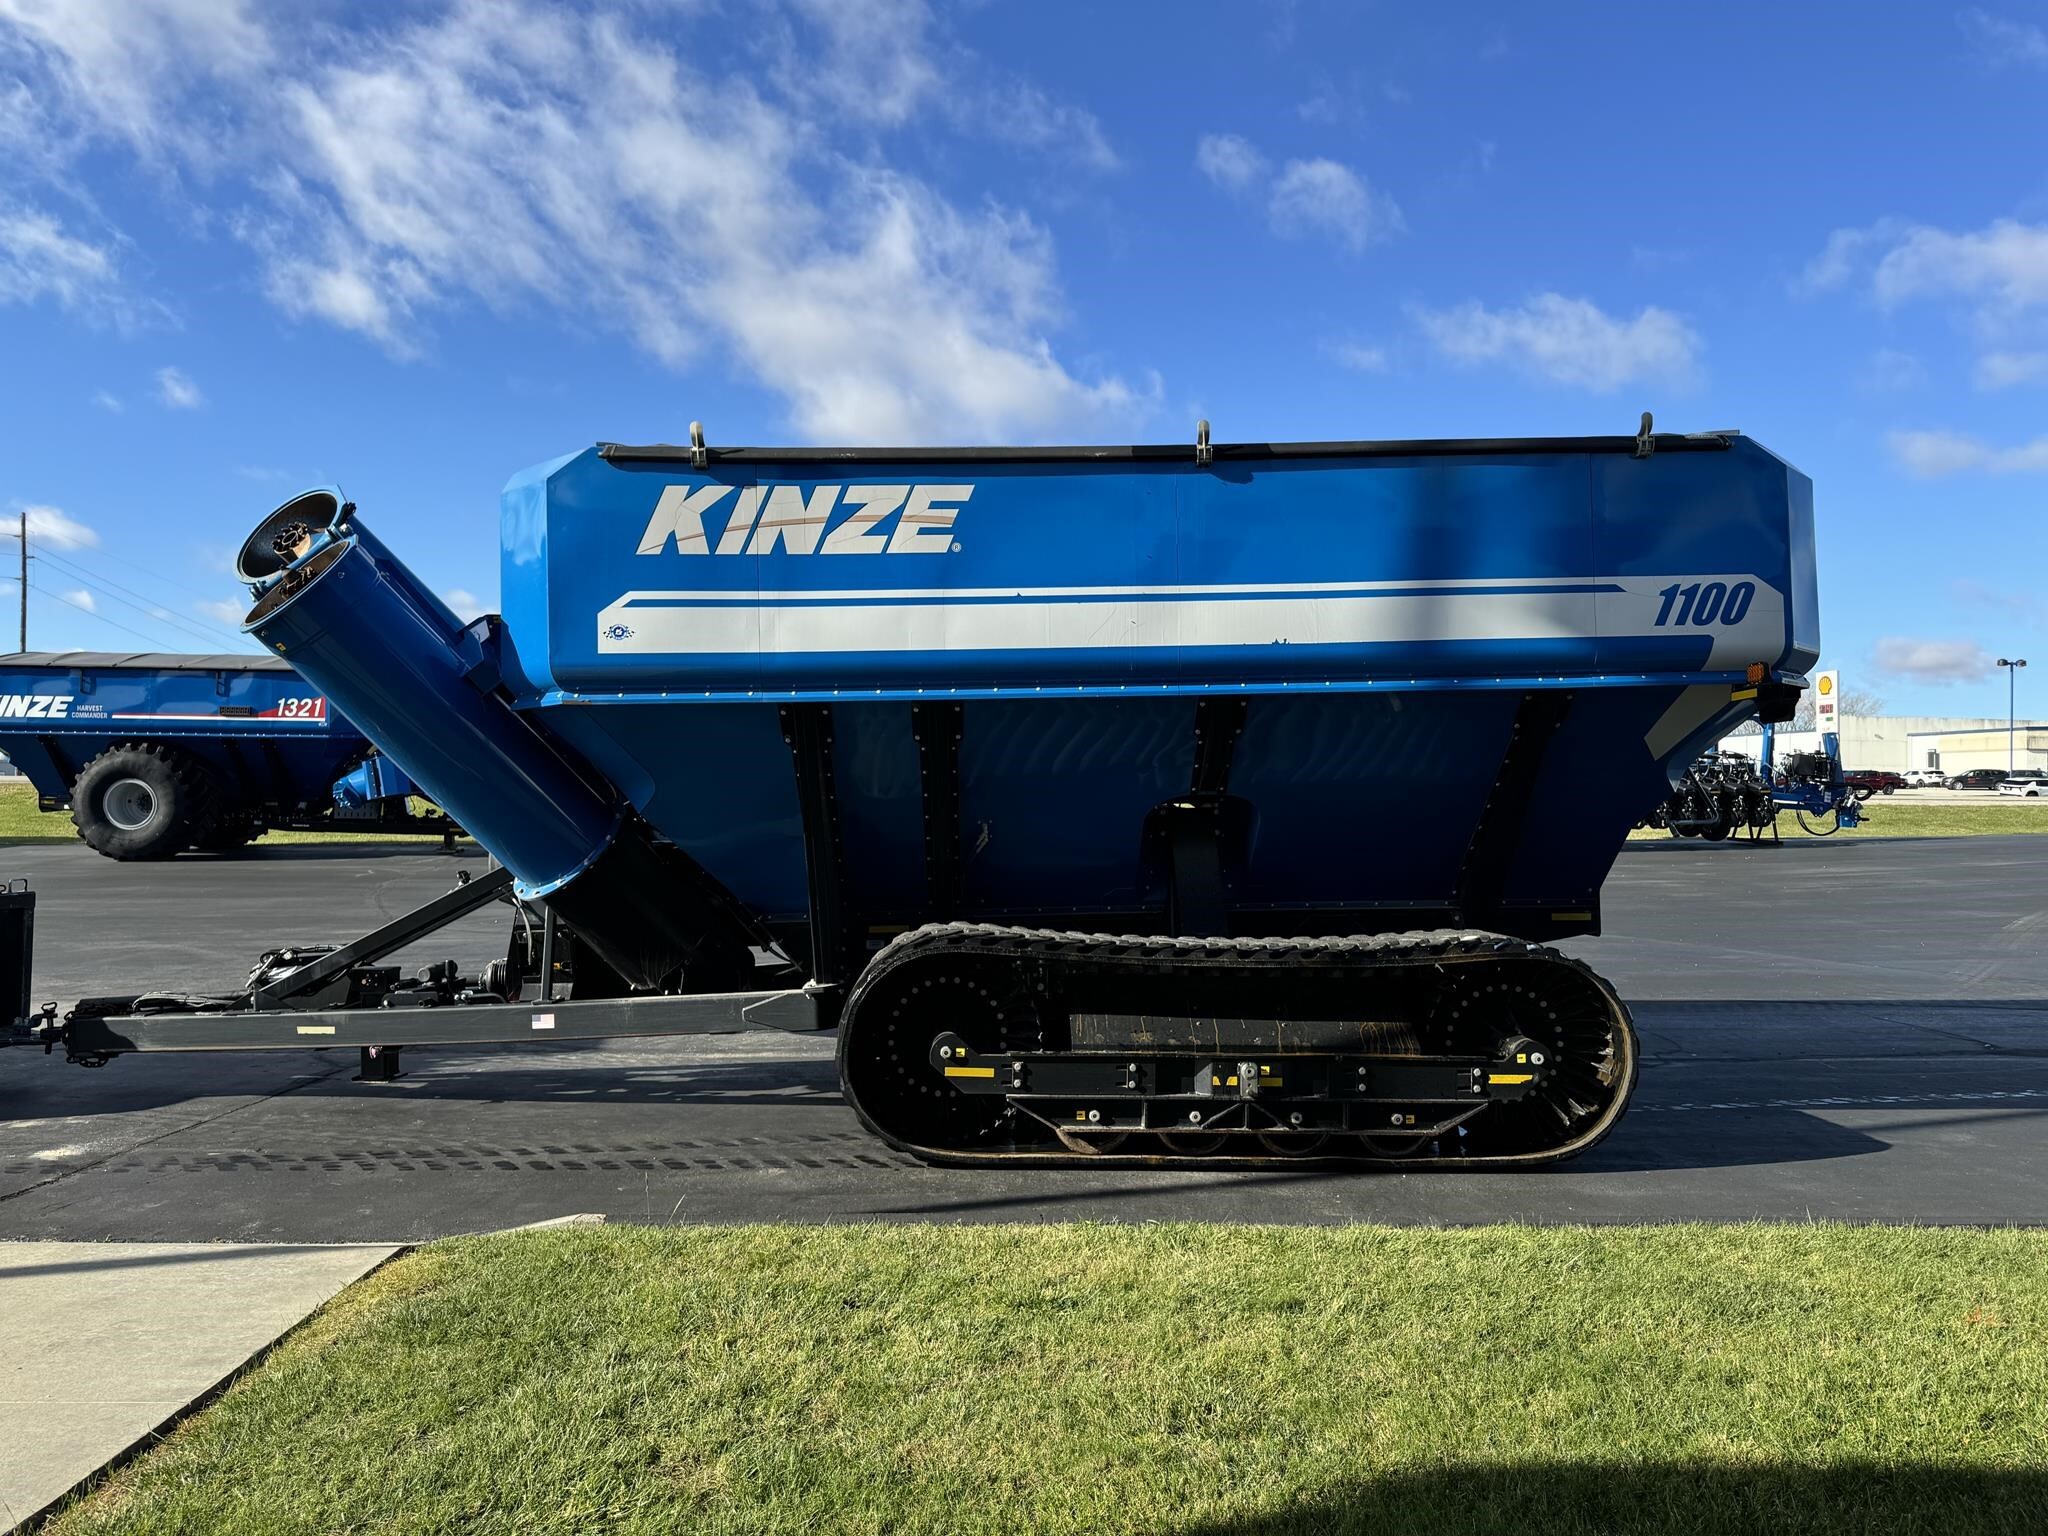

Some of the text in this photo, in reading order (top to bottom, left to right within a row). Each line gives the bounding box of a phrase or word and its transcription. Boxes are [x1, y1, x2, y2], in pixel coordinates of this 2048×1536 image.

[635, 485, 975, 555] KINZE
[1654, 582, 1756, 626] 1100
[0, 695, 75, 718] INZE
[71, 711, 108, 719] COMMANDER
[277, 697, 323, 717] 1321
